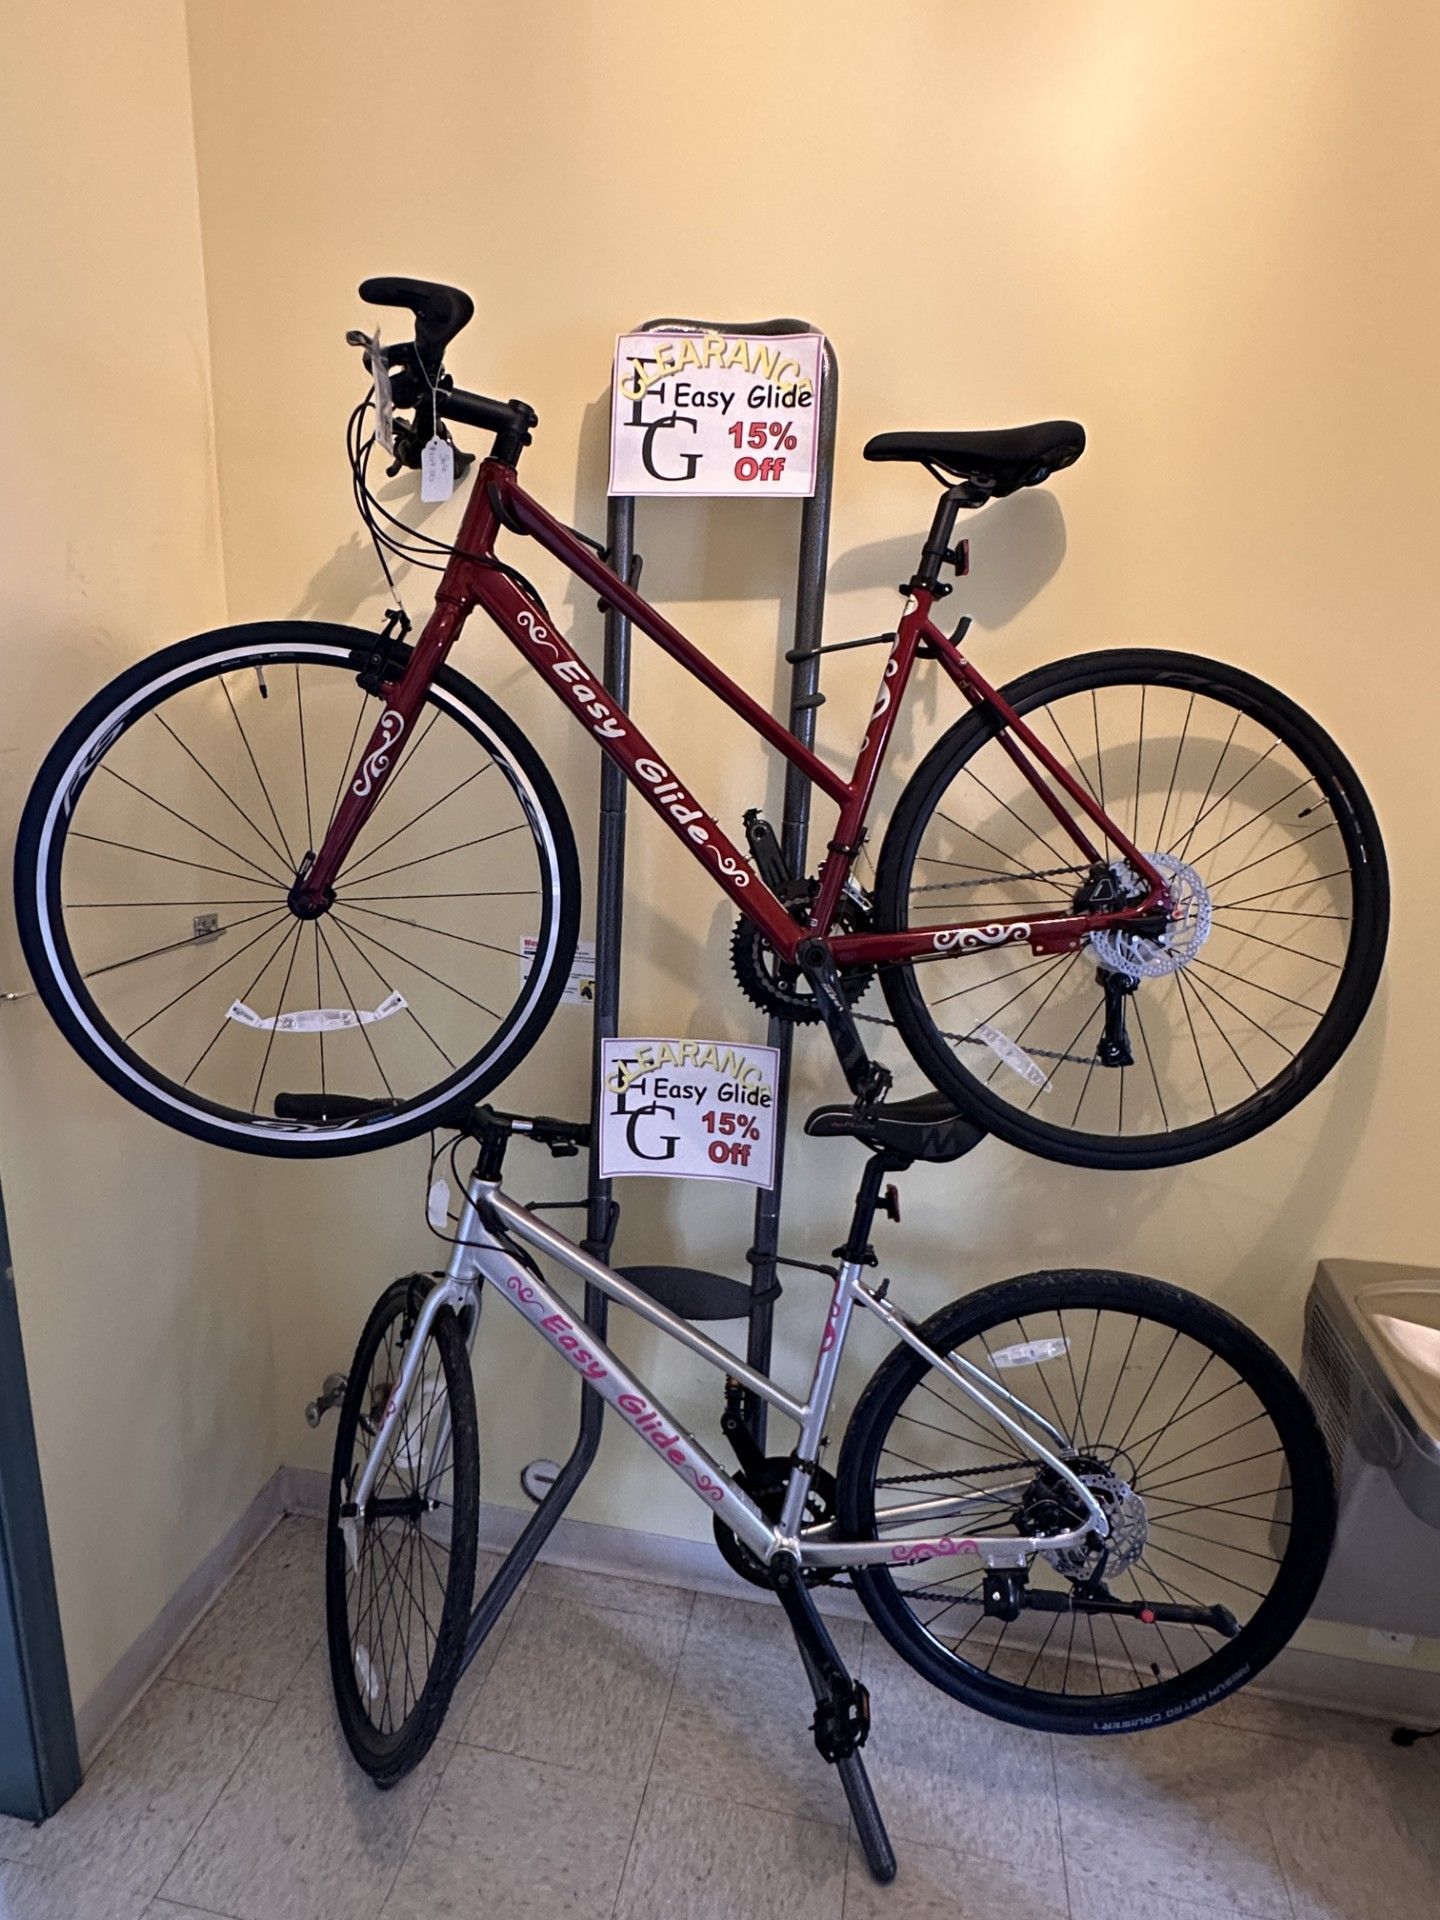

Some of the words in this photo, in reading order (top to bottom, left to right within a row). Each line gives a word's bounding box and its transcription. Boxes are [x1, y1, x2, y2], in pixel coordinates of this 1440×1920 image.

[674, 382, 735, 416] Easy
[747, 384, 812, 408] Glide
[728, 420, 798, 451] 15%
[734, 456, 786, 481] Off
[552, 660, 626, 739] Easy
[635, 758, 709, 845] Glide
[654, 1078, 707, 1105] Easy
[717, 1083, 772, 1108] Glide
[701, 1110, 760, 1140] 15%
[708, 1141, 751, 1166] Off
[540, 1314, 607, 1380] Easy
[617, 1394, 687, 1466] Glide
